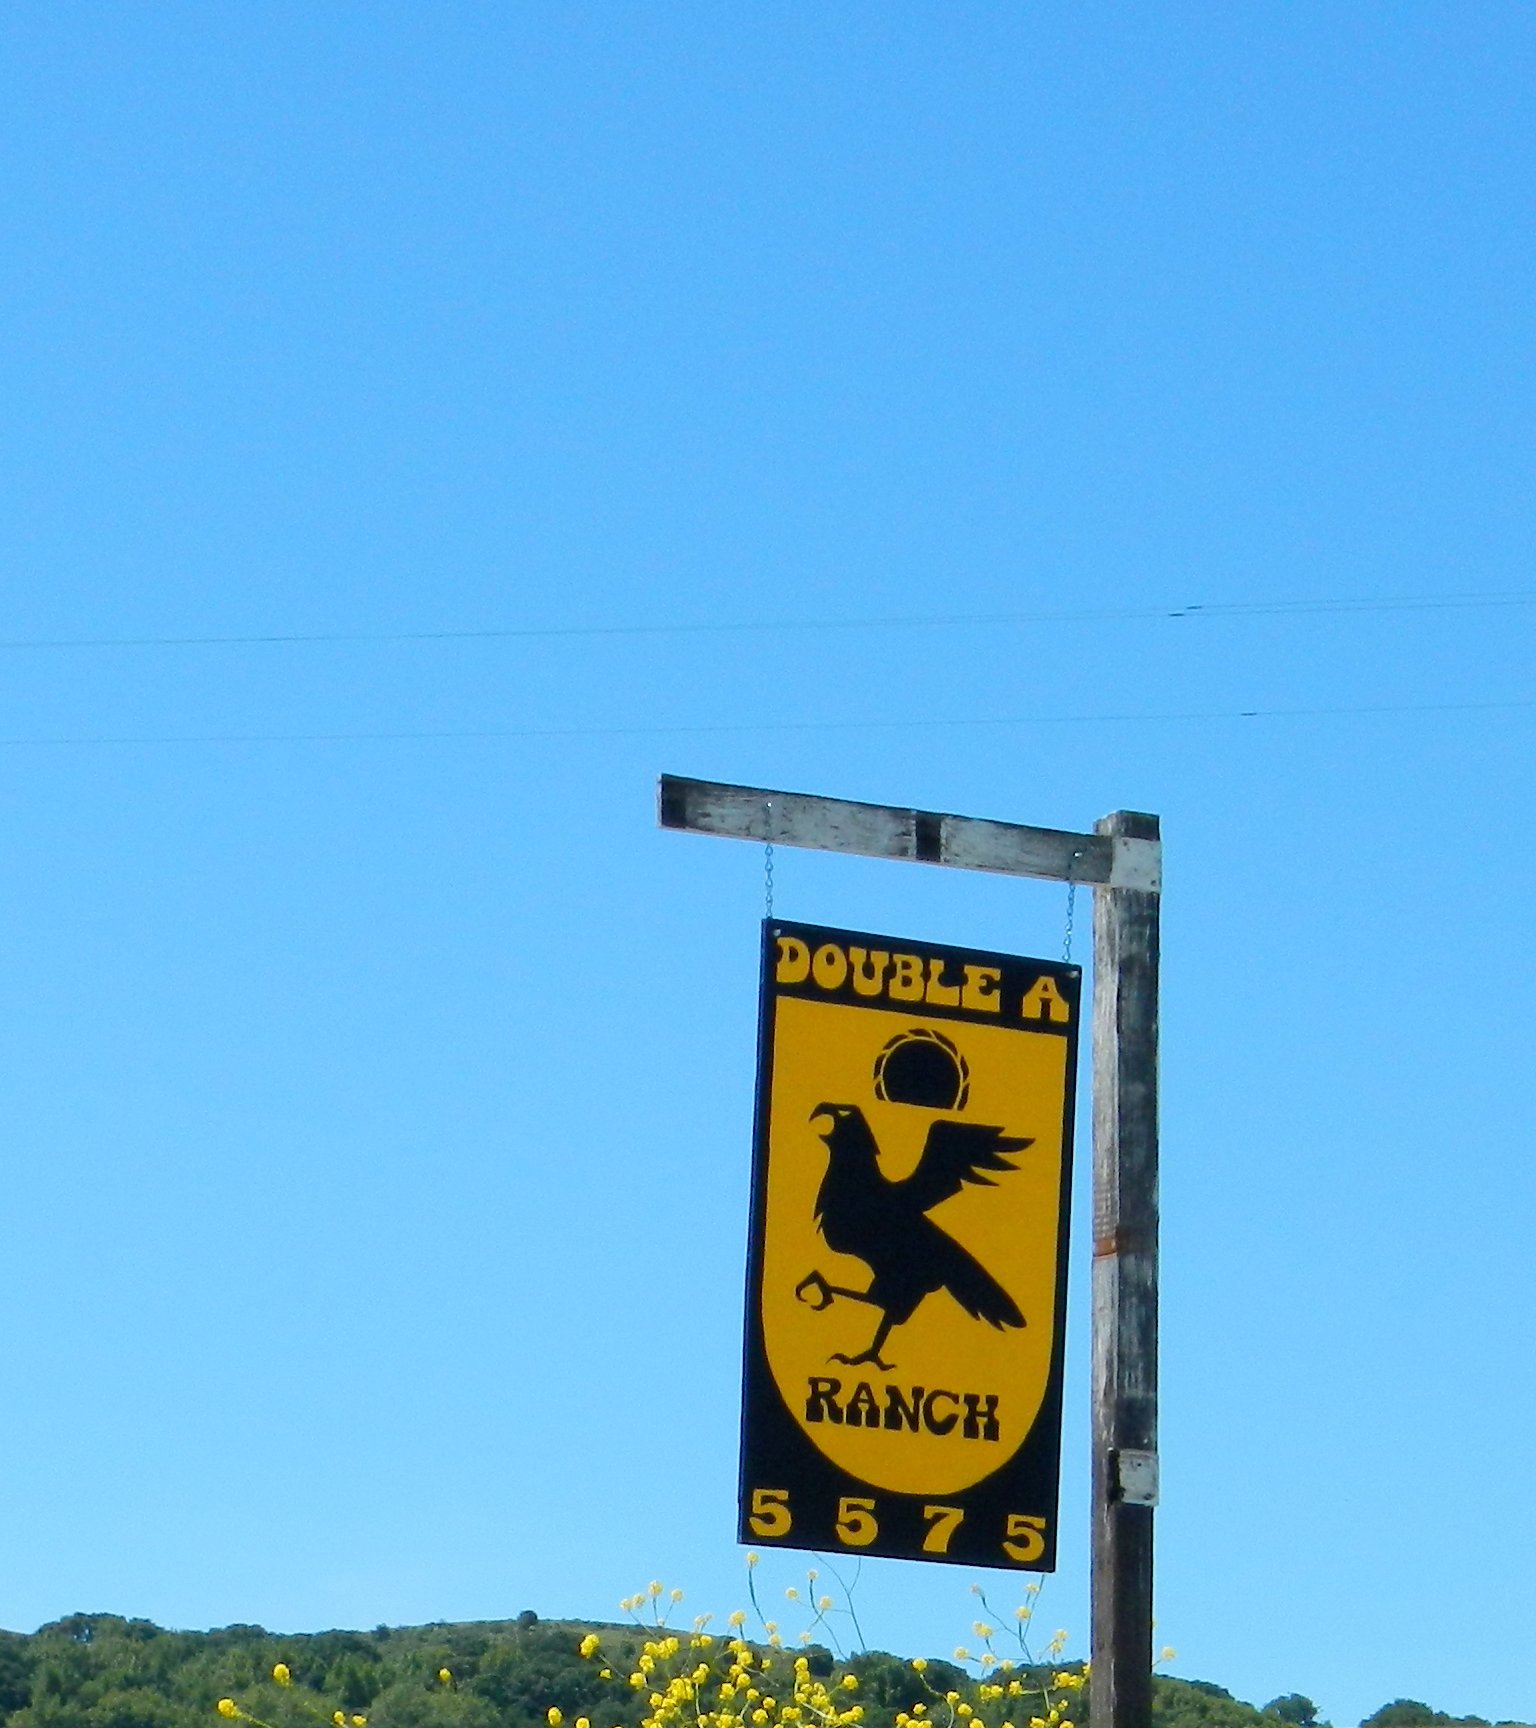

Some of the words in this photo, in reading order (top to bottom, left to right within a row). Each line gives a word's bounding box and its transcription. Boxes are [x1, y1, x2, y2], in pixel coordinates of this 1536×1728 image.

[776, 936, 1001, 1012] DOUBLE
[1022, 975, 1070, 1022] A
[805, 1376, 1000, 1441] RANCH
